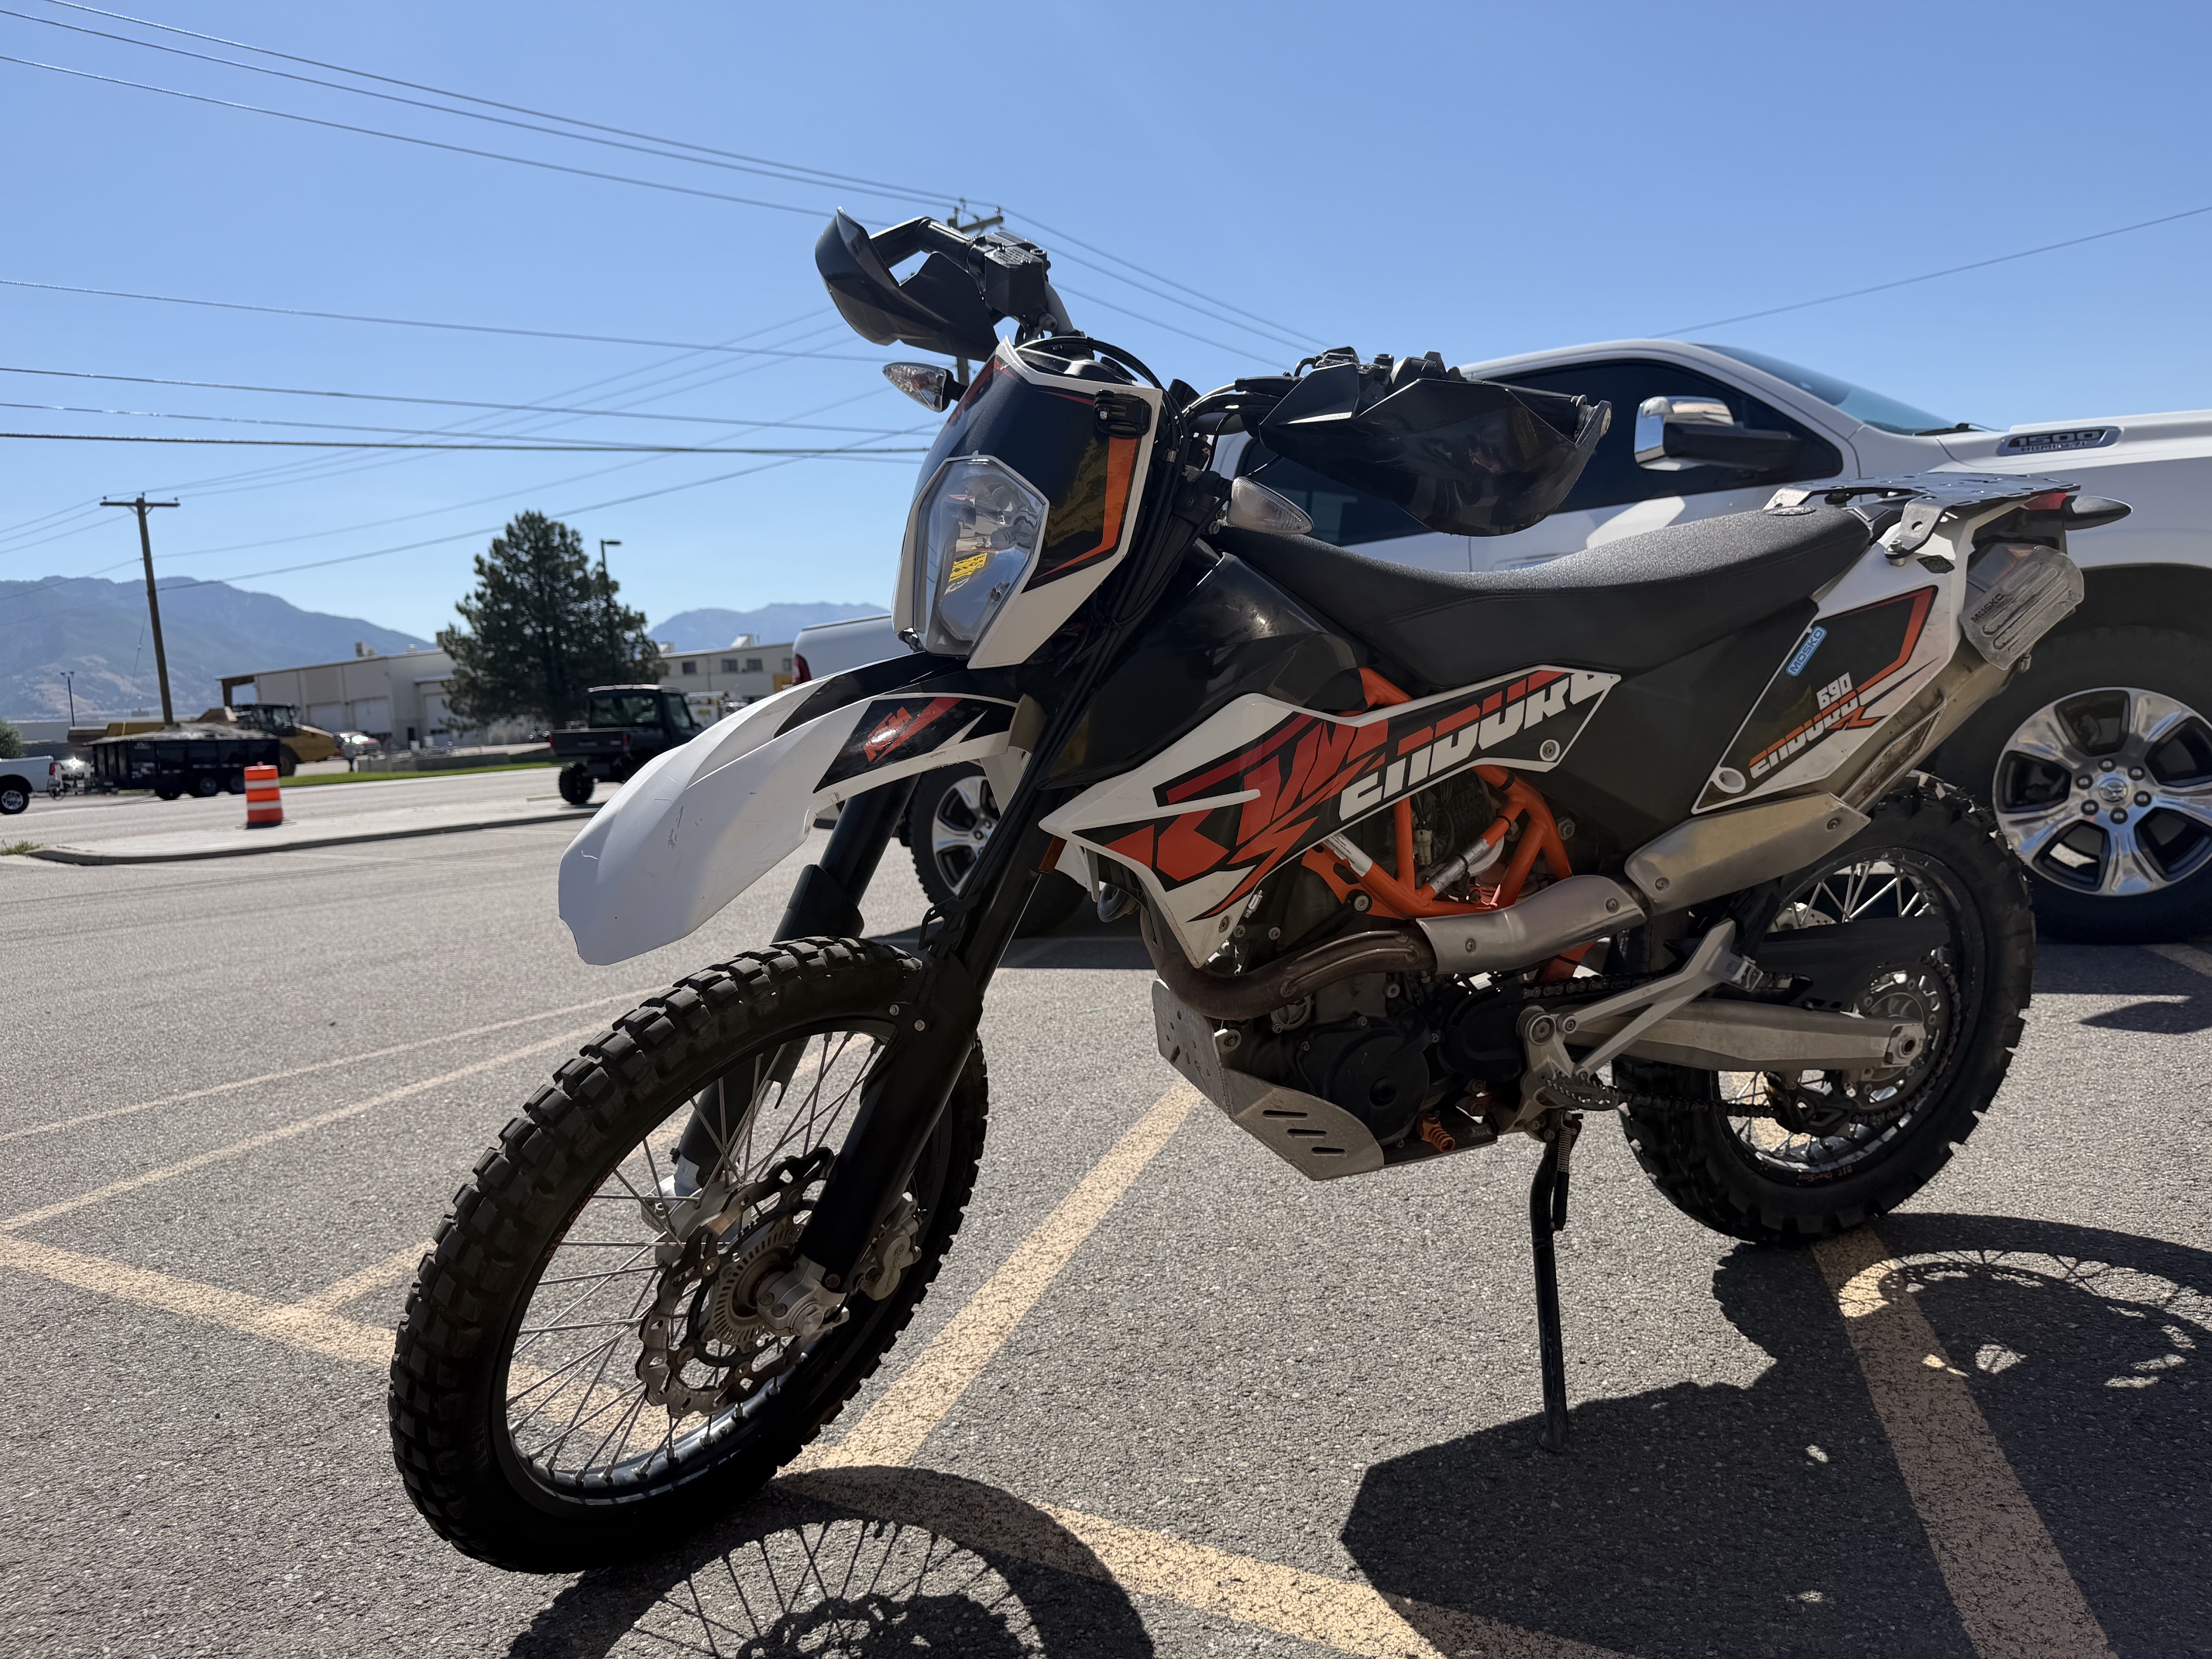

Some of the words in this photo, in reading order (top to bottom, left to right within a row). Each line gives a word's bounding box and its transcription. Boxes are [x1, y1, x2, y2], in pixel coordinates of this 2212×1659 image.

[2018, 431, 2100, 446] 1500
[1970, 593, 2004, 623] MOSKO
[1789, 628, 1824, 674] MOSKO
[1816, 672, 1852, 710] 690
[863, 706, 912, 762] KTM
[1339, 669, 1617, 821] ENDURO
[1749, 691, 1858, 779] ENDURO
[1104, 713, 1389, 882] KTM
